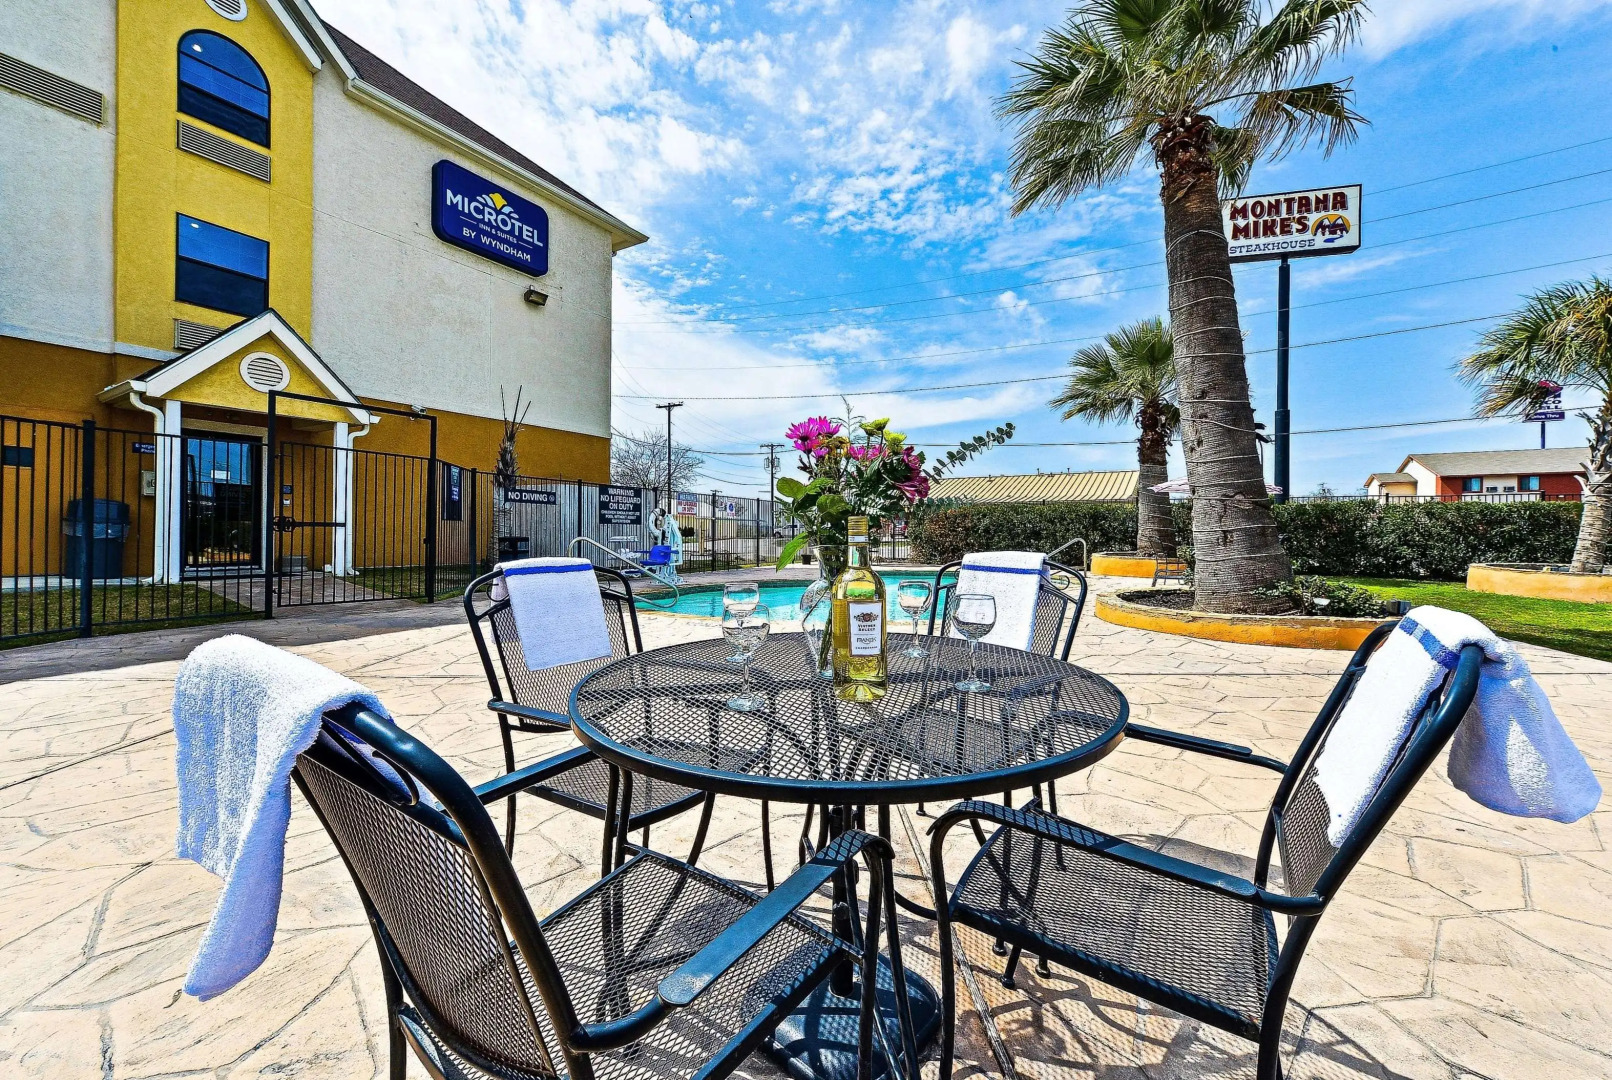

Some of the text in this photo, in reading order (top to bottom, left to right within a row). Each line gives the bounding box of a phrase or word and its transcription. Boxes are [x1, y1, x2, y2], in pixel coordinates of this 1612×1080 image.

[1229, 191, 1348, 221] MONTANA
[446, 189, 543, 247] MICROTEL
[1231, 215, 1310, 240] MIKE'S
[478, 222, 490, 232] INN
[496, 230, 517, 244] SUITES
[462, 227, 531, 262] BY WYNDHAM
[1229, 238, 1316, 254] STEAKHOUSE
[508, 492, 548, 502] NO DIVING
[608, 488, 634, 496] WARNING
[610, 495, 641, 504] LIFEGUARD
